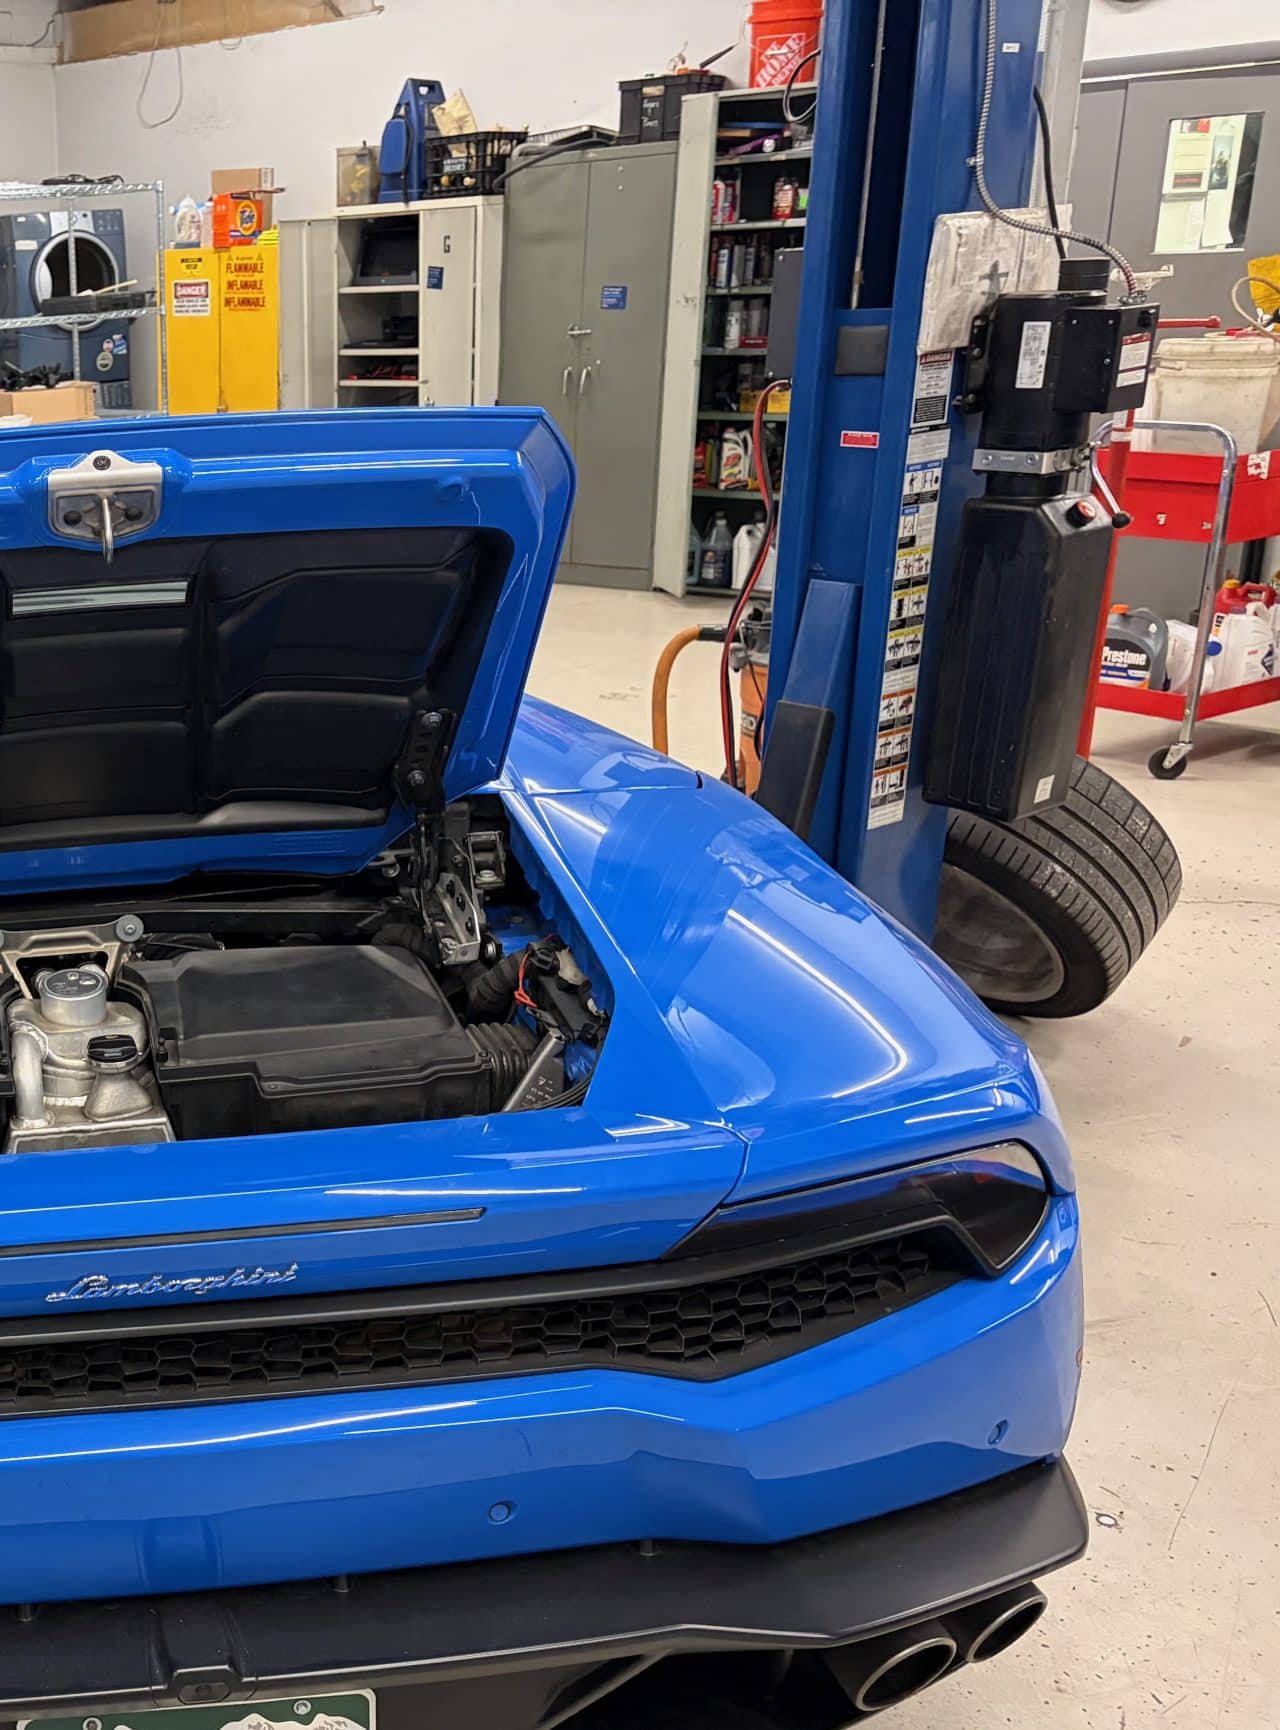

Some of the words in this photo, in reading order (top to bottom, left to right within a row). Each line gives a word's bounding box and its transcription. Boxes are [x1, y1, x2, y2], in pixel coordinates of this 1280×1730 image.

[756, 33, 805, 88] HOME
[240, 208, 255, 227] Tide
[443, 234, 451, 254] G
[226, 263, 265, 273] FLAMMABLE
[176, 284, 206, 297] DANGER
[1102, 646, 1147, 666] Prestone
[45, 1262, 299, 1303] Lamborghini
